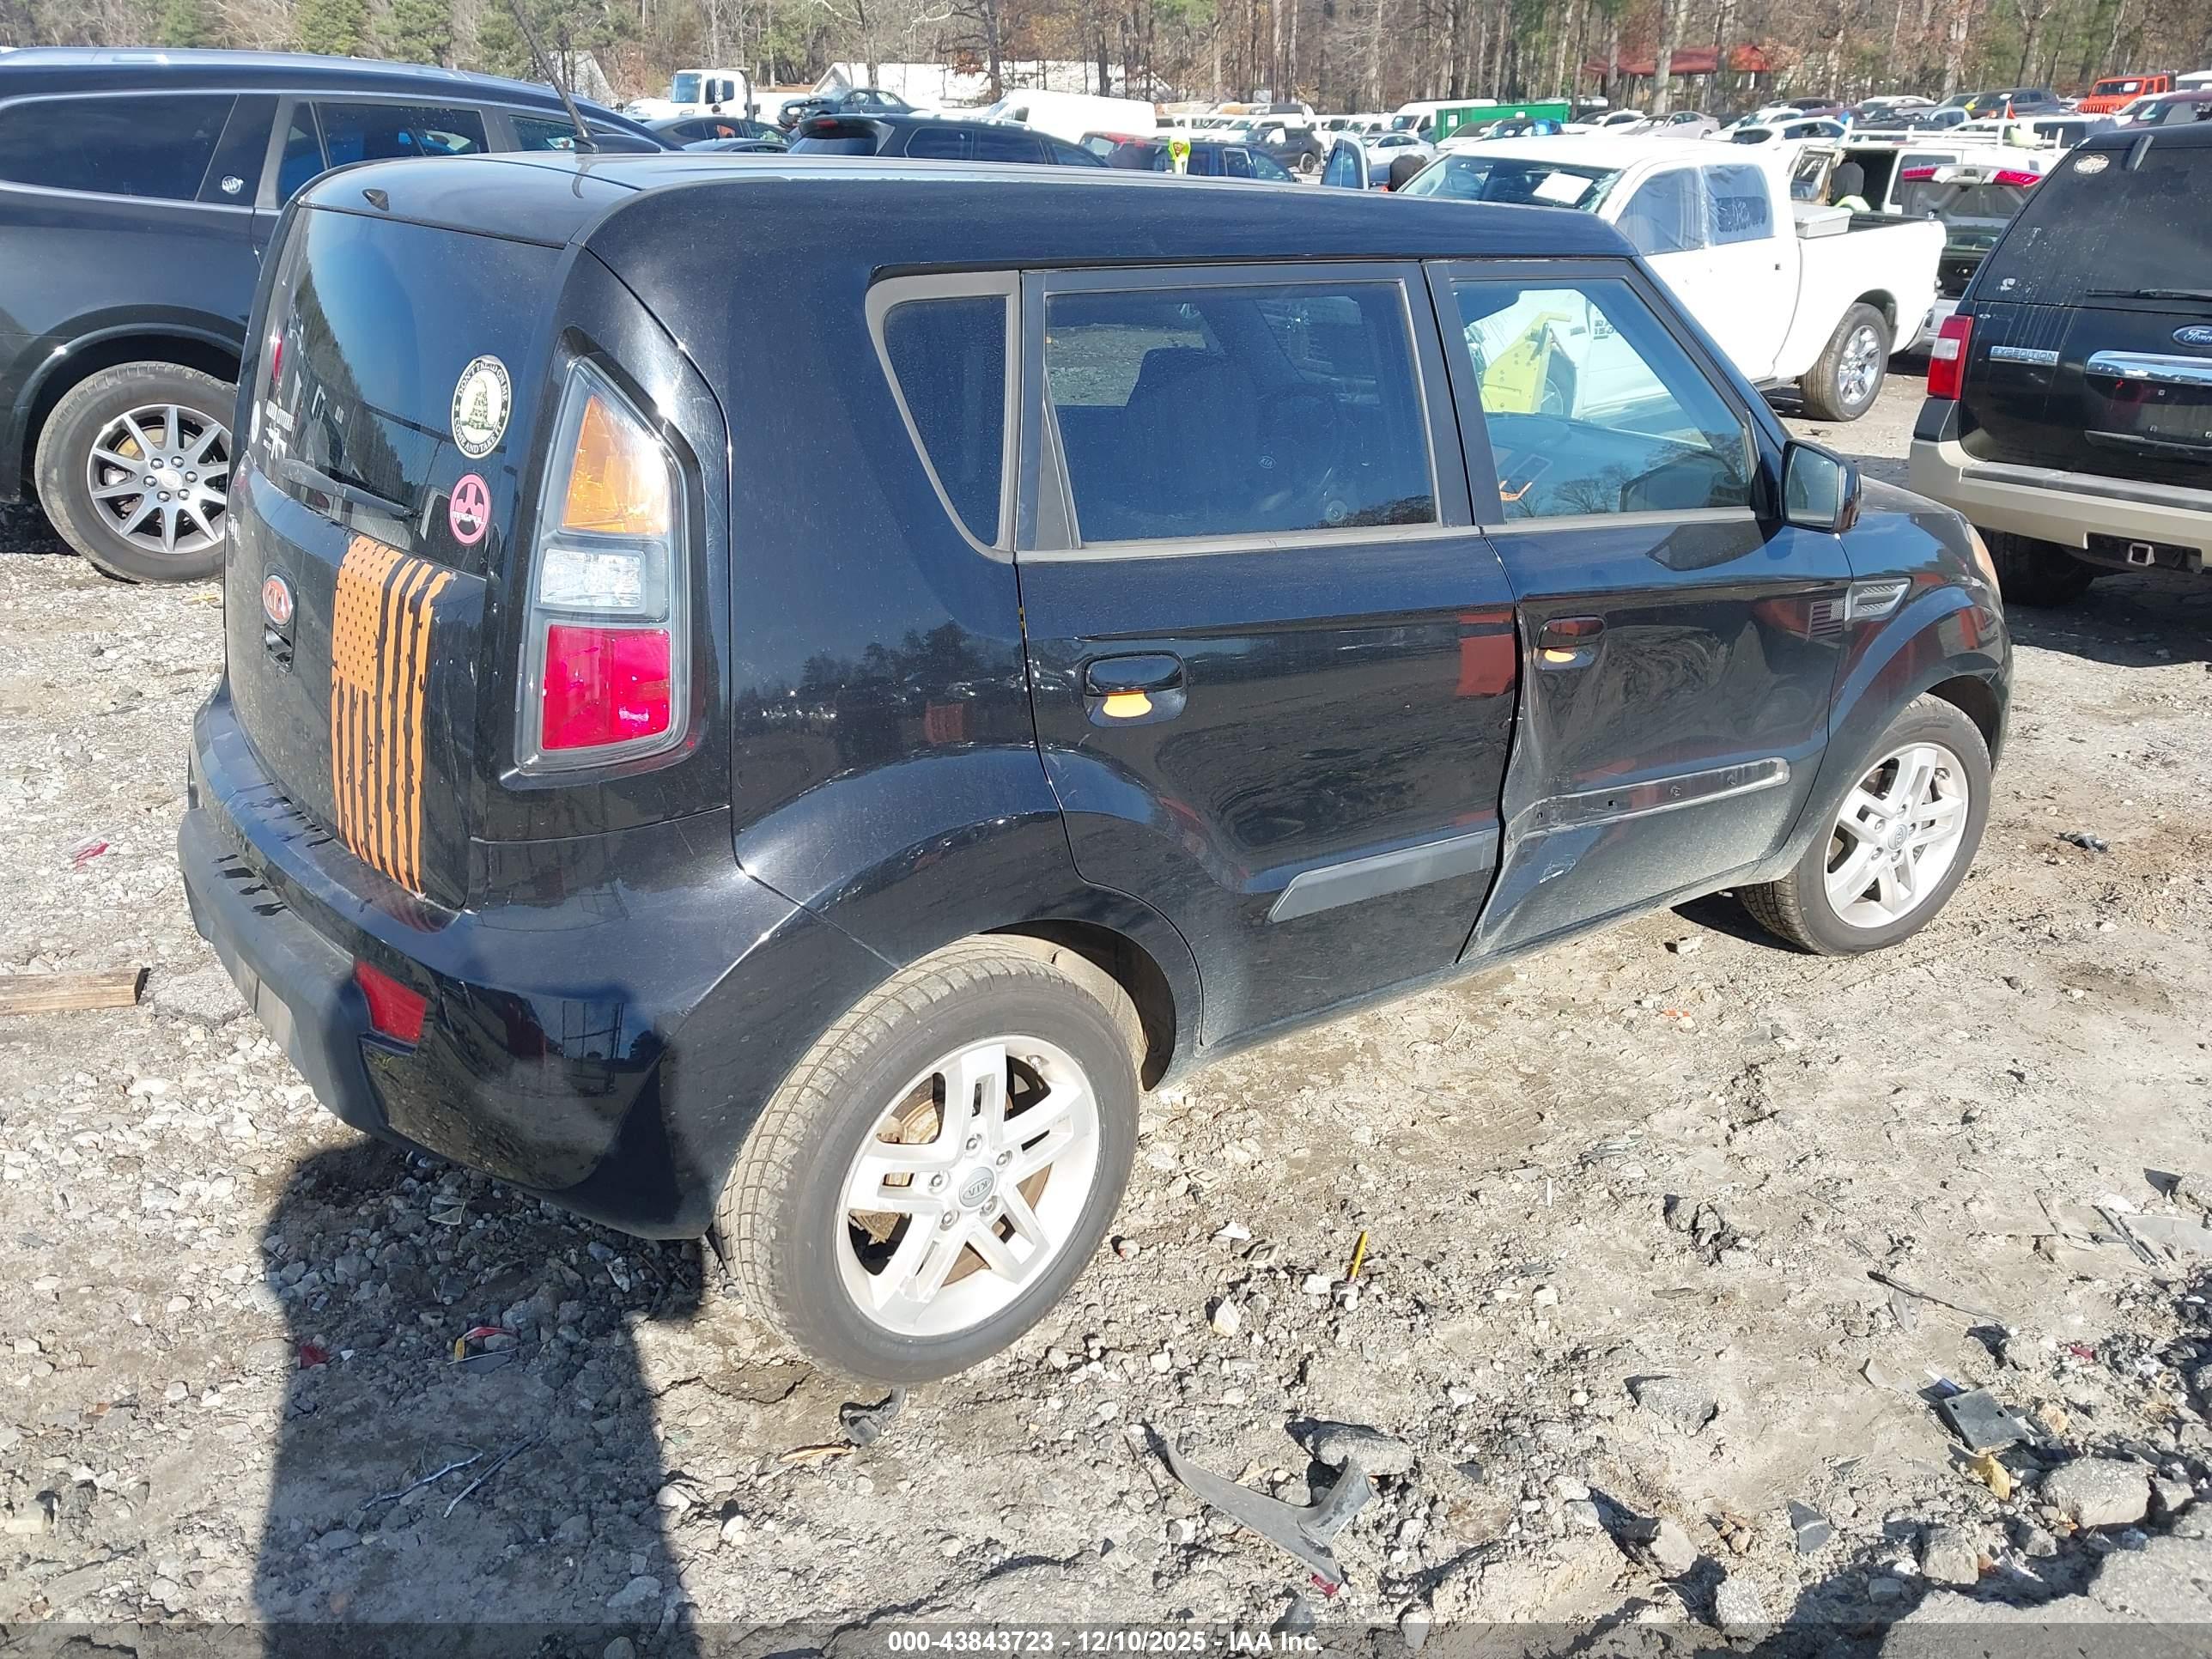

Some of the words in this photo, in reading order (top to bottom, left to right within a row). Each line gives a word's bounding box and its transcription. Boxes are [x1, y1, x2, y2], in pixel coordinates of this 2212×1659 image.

[1991, 346, 2057, 361] EXPEDITION
[458, 364, 476, 396] DON'T
[501, 383, 508, 403] ME
[454, 416, 466, 447] COME
[465, 442, 480, 453] AND
[479, 434, 497, 453] TAKE
[495, 422, 503, 436] IT
[267, 583, 286, 618] KIA
[968, 1179, 991, 1197] KIA
